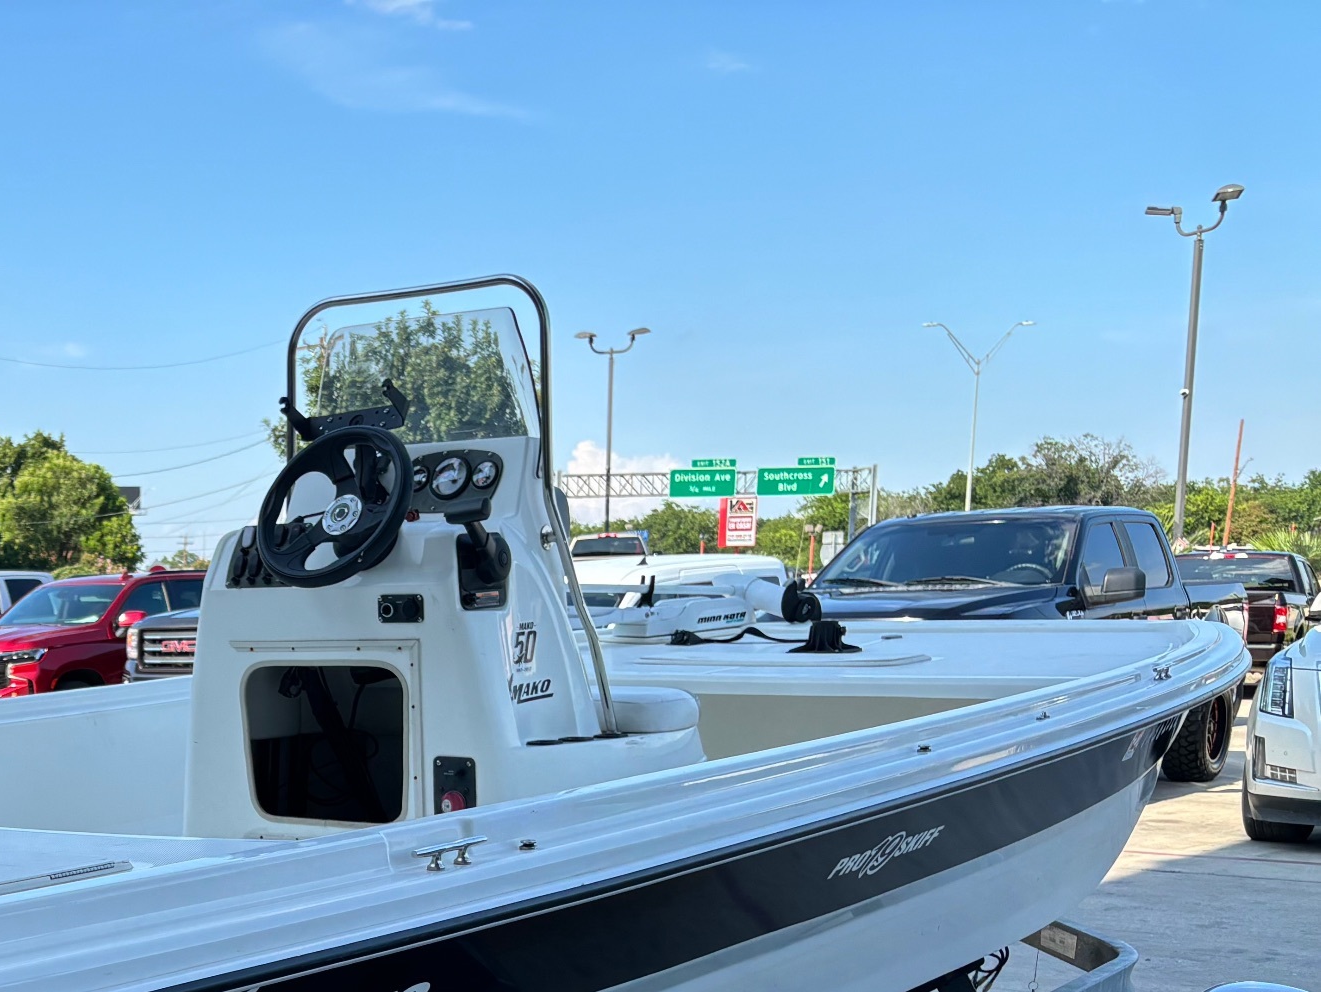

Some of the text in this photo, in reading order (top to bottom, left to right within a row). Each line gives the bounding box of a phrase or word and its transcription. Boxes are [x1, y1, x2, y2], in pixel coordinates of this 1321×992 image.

[674, 472, 731, 482] Division Ave
[763, 471, 813, 481] Southcross
[778, 482, 797, 492] Blvd
[723, 611, 746, 621] KOTA
[519, 622, 535, 630] MAKO
[161, 640, 196, 652] GMC
[513, 630, 537, 665] 50
[512, 679, 554, 704] MAKO
[894, 825, 945, 858] SKIFF
